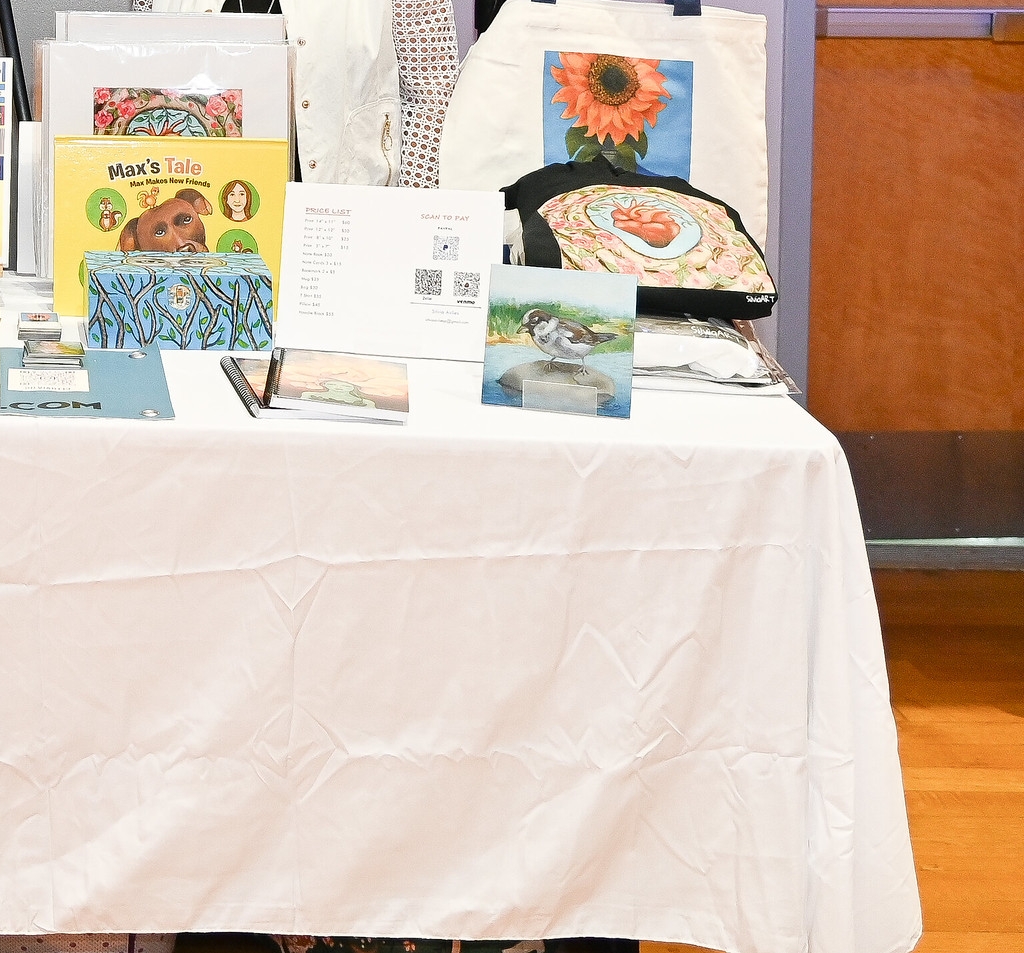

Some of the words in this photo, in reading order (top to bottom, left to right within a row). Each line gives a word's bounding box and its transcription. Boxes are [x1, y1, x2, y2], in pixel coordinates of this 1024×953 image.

[107, 158, 161, 181] Max's
[164, 157, 202, 176] Tale
[185, 178, 211, 188] Friends
